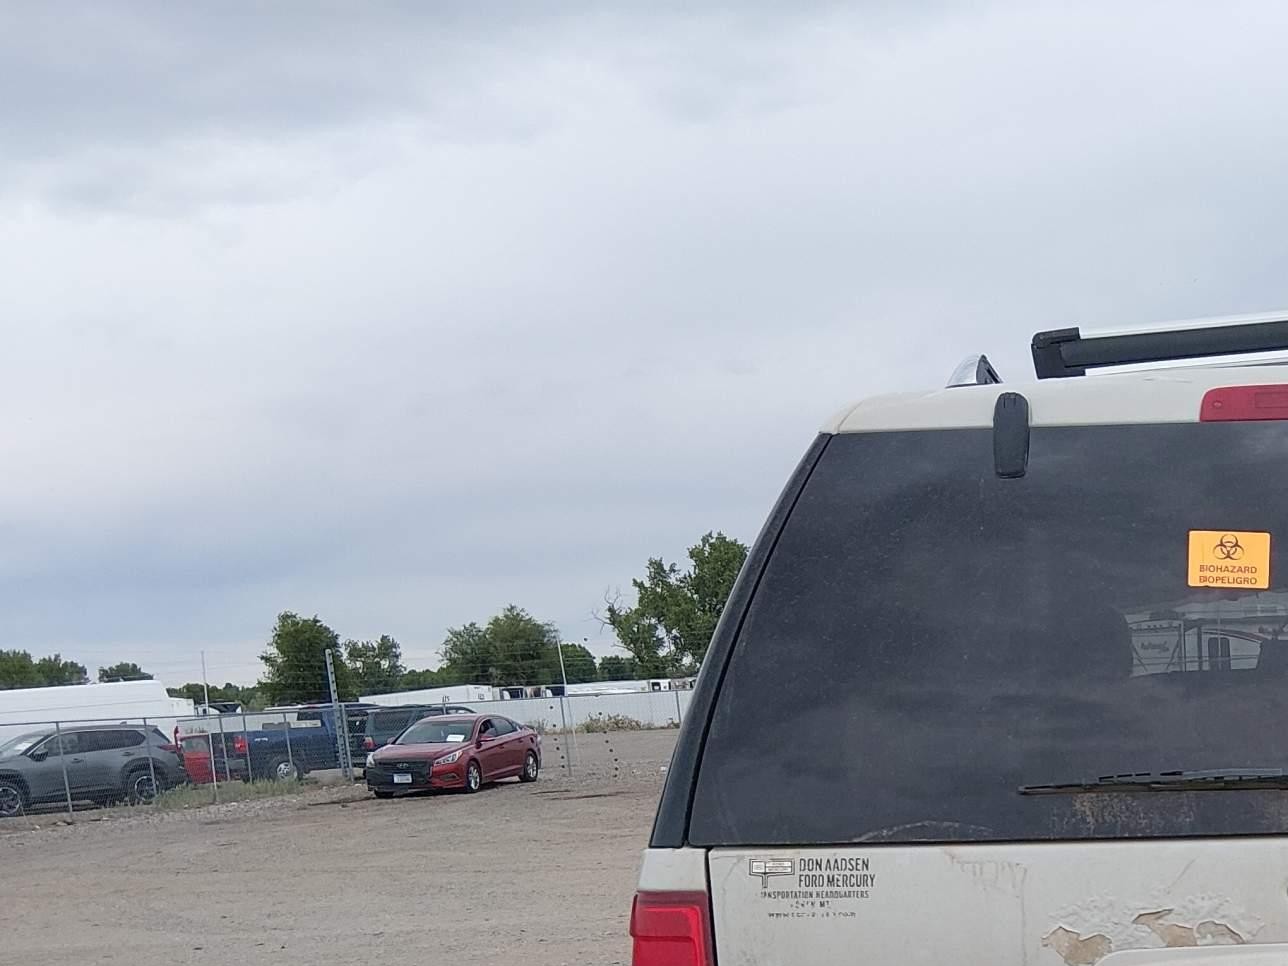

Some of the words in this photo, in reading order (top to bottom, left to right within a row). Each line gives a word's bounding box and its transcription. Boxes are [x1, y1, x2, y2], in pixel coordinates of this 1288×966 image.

[1199, 565, 1258, 574] BIOHAZARD
[1198, 576, 1258, 585] BIOPELIGRO
[799, 858, 823, 872] DON
[825, 858, 870, 872] AADSEN
[798, 874, 825, 888] FORD
[826, 874, 876, 888] MERCURY
[815, 890, 870, 899] HEADQUARTERS
